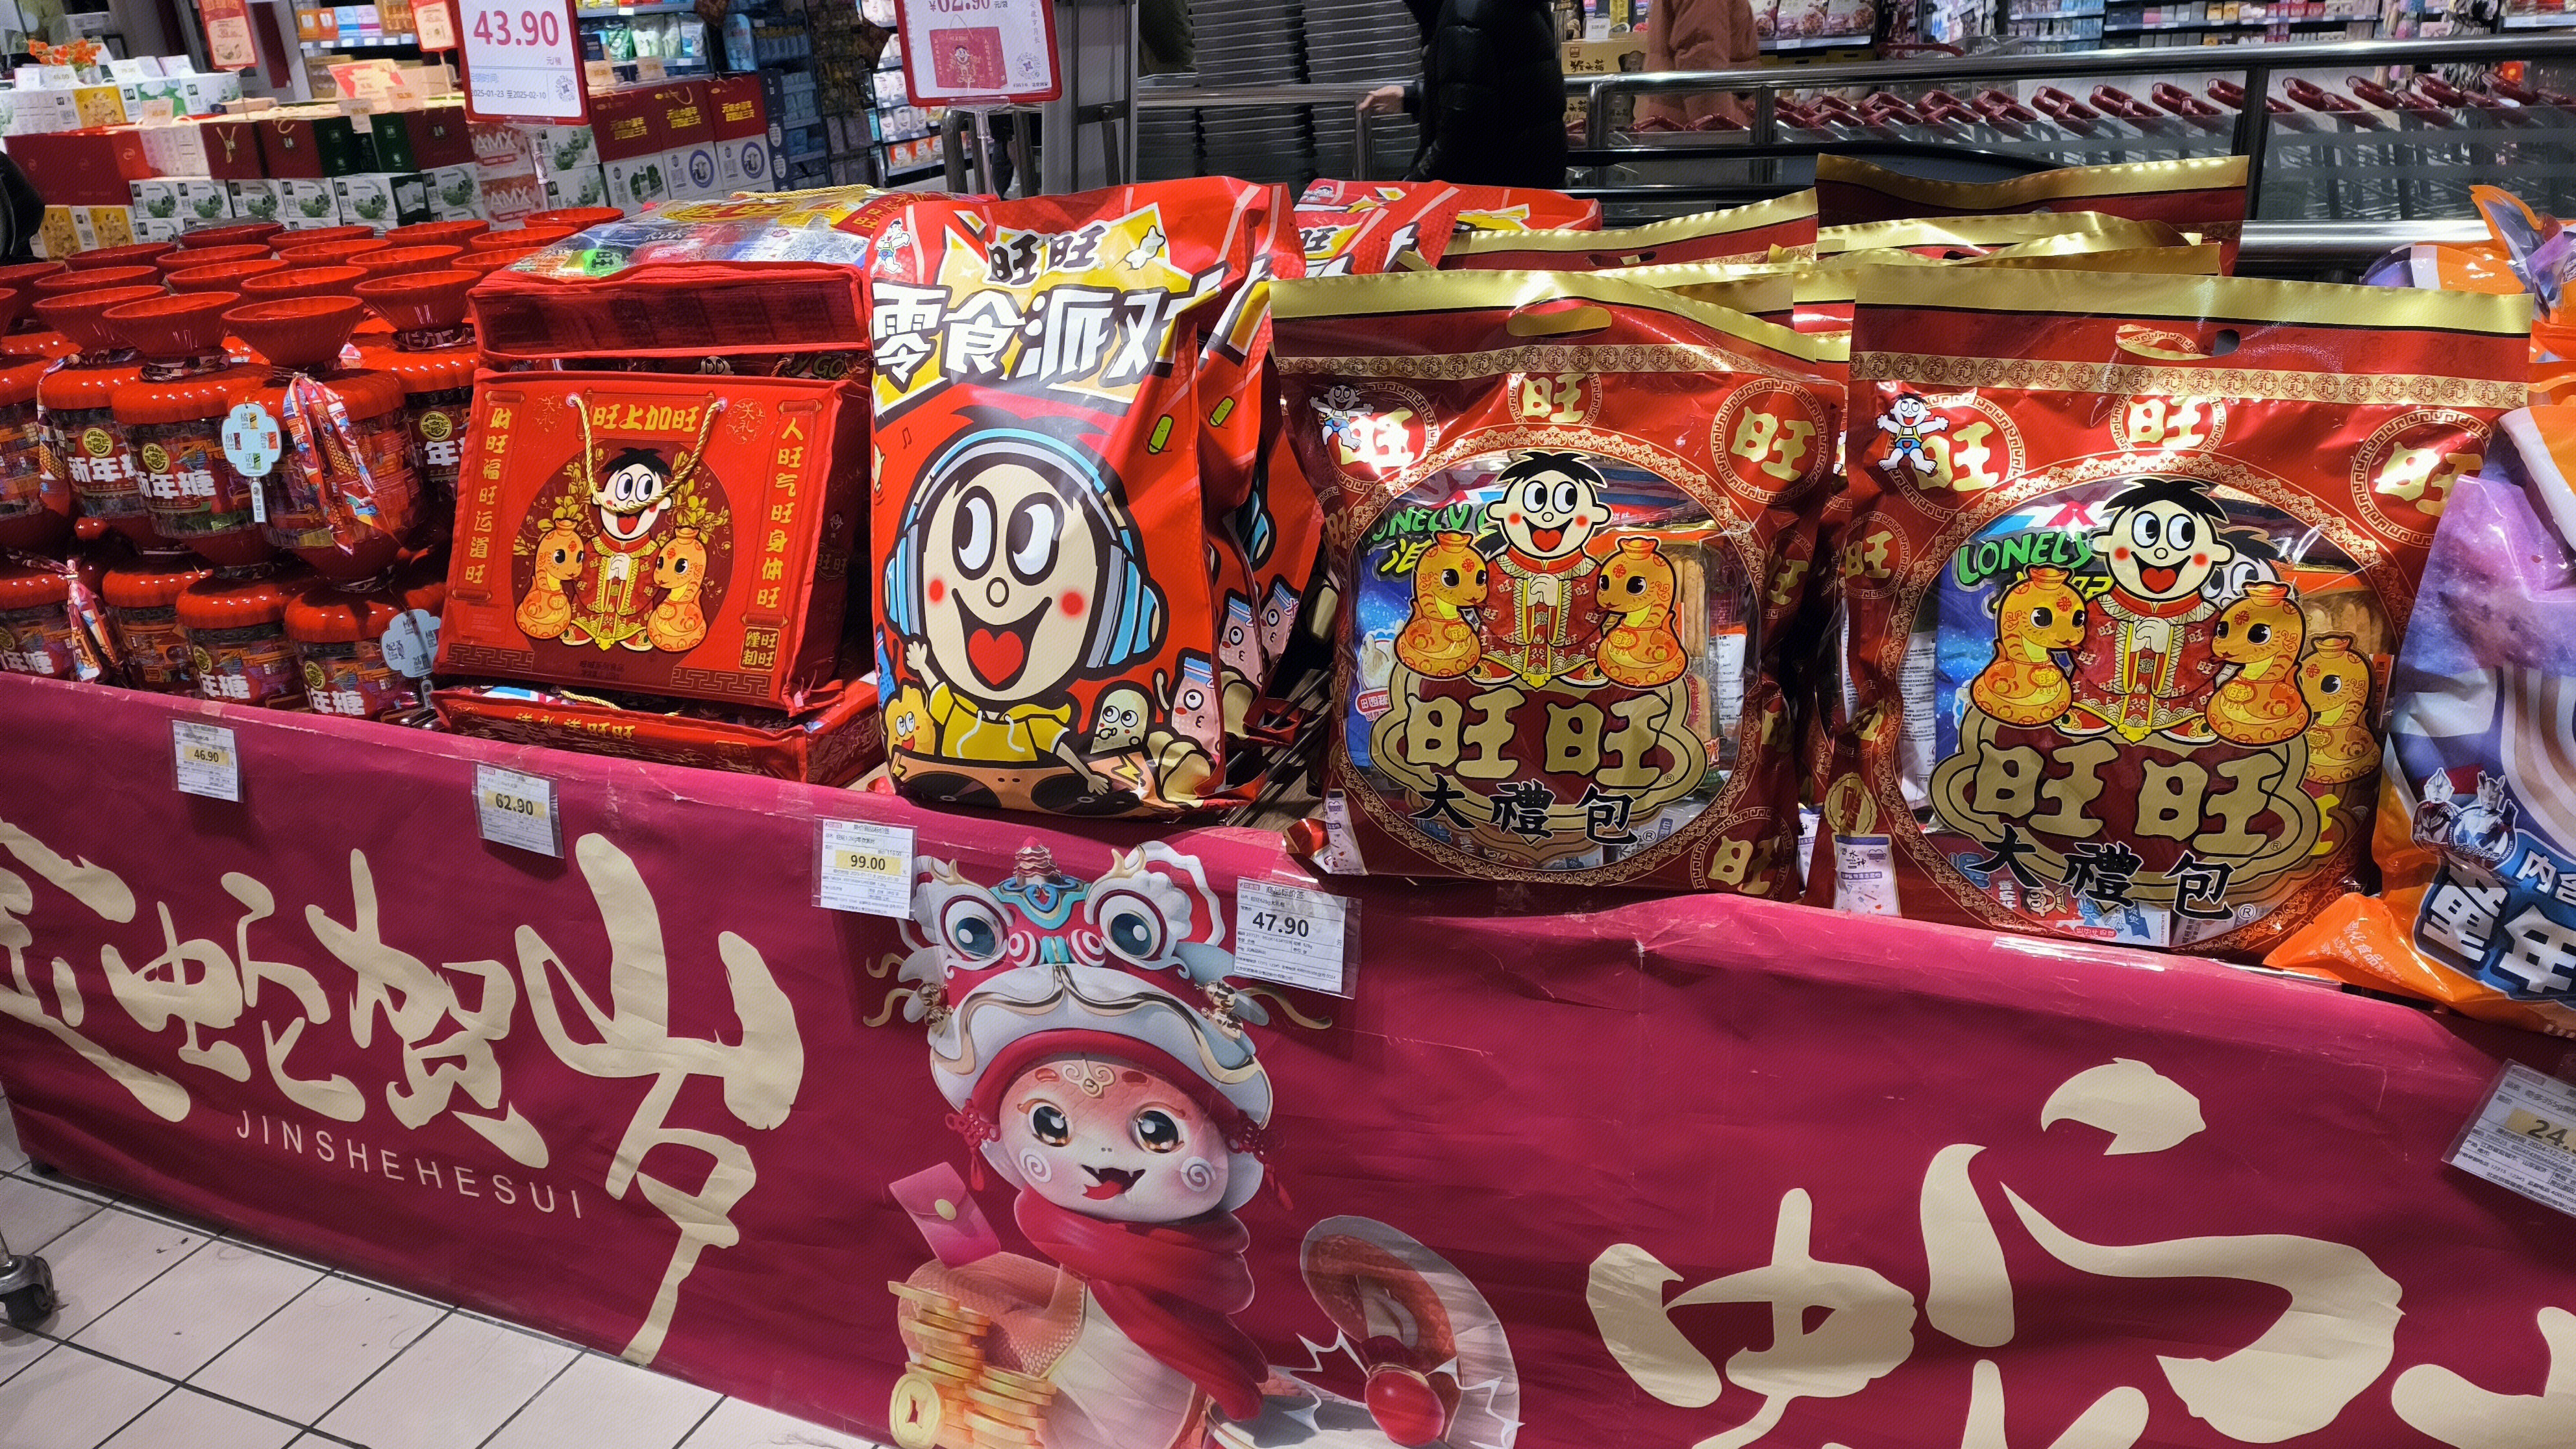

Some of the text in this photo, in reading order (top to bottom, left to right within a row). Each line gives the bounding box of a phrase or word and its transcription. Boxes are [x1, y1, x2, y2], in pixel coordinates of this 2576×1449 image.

[474, 10, 559, 46] 43.90
[987, 225, 1107, 284] 旺旺
[593, 403, 700, 432] 旺上加旺
[1522, 372, 1592, 424] 旺
[1729, 405, 1816, 482] 旺
[465, 407, 512, 584] 财旺福旺运道旺
[757, 417, 804, 608] 人旺气旺身体旺
[1958, 531, 2092, 584] LONELY
[194, 749, 219, 763] 46.90
[1402, 687, 1674, 786] 旺旺
[495, 793, 534, 816] 62.90
[1410, 774, 1639, 846] 大禮包
[1970, 739, 2285, 858] 旺旺
[850, 854, 886, 871] 99.00
[1968, 823, 2237, 922] 大禮包
[1265, 886, 1304, 899] 商品标价签
[1252, 911, 1309, 937] 47.90
[2527, 1119, 2576, 1154] 24.
[2527, 1140, 2570, 1162] 2024-12-25
[237, 1110, 582, 1219] JINSHEHESUI
